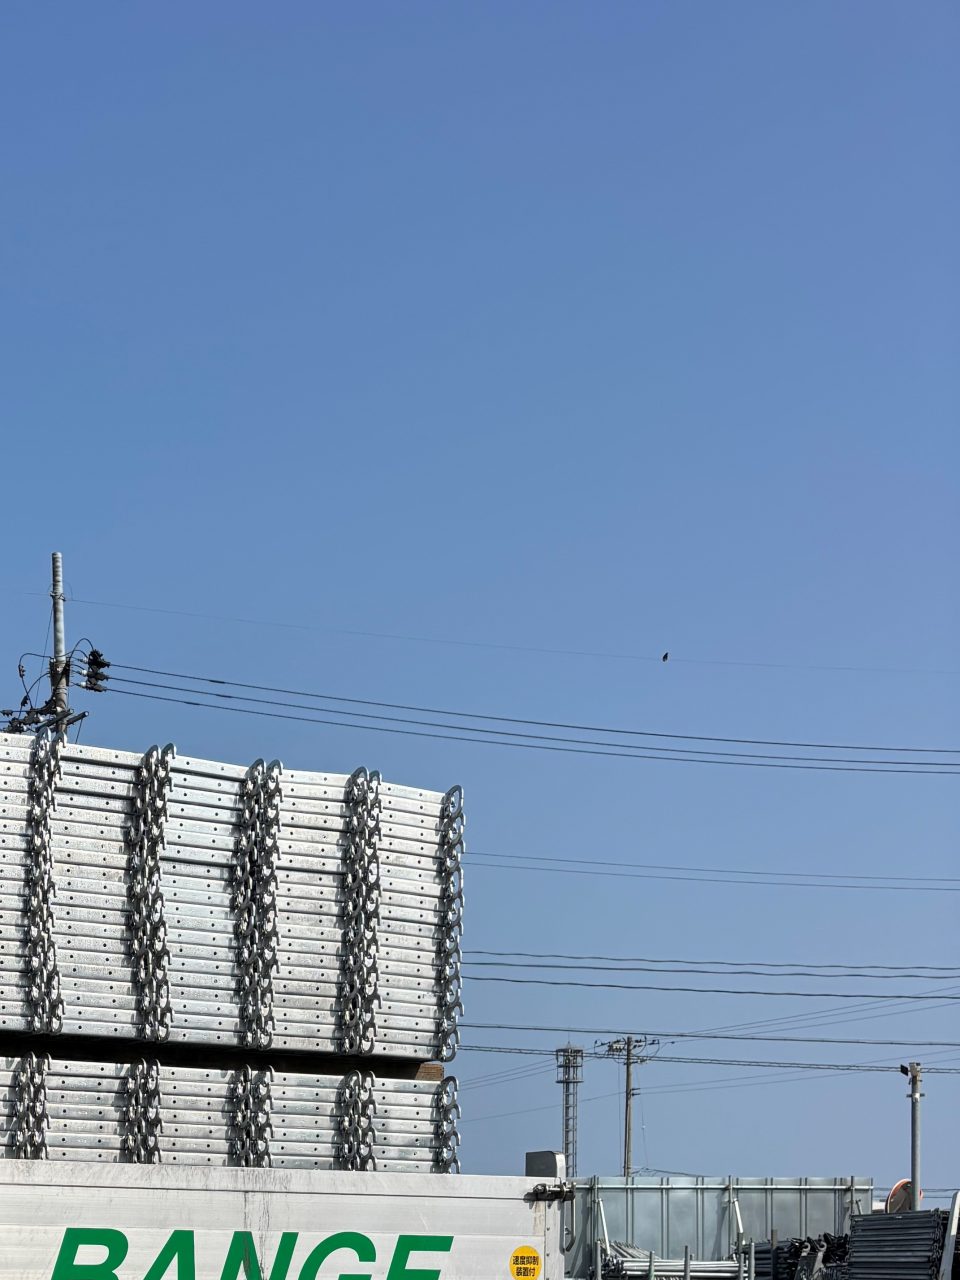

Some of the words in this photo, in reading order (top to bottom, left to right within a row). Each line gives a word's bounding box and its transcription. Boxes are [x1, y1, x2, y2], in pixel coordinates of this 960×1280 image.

[512, 1255, 540, 1266] 速度抑制
[515, 1266, 536, 1277] 装置付
